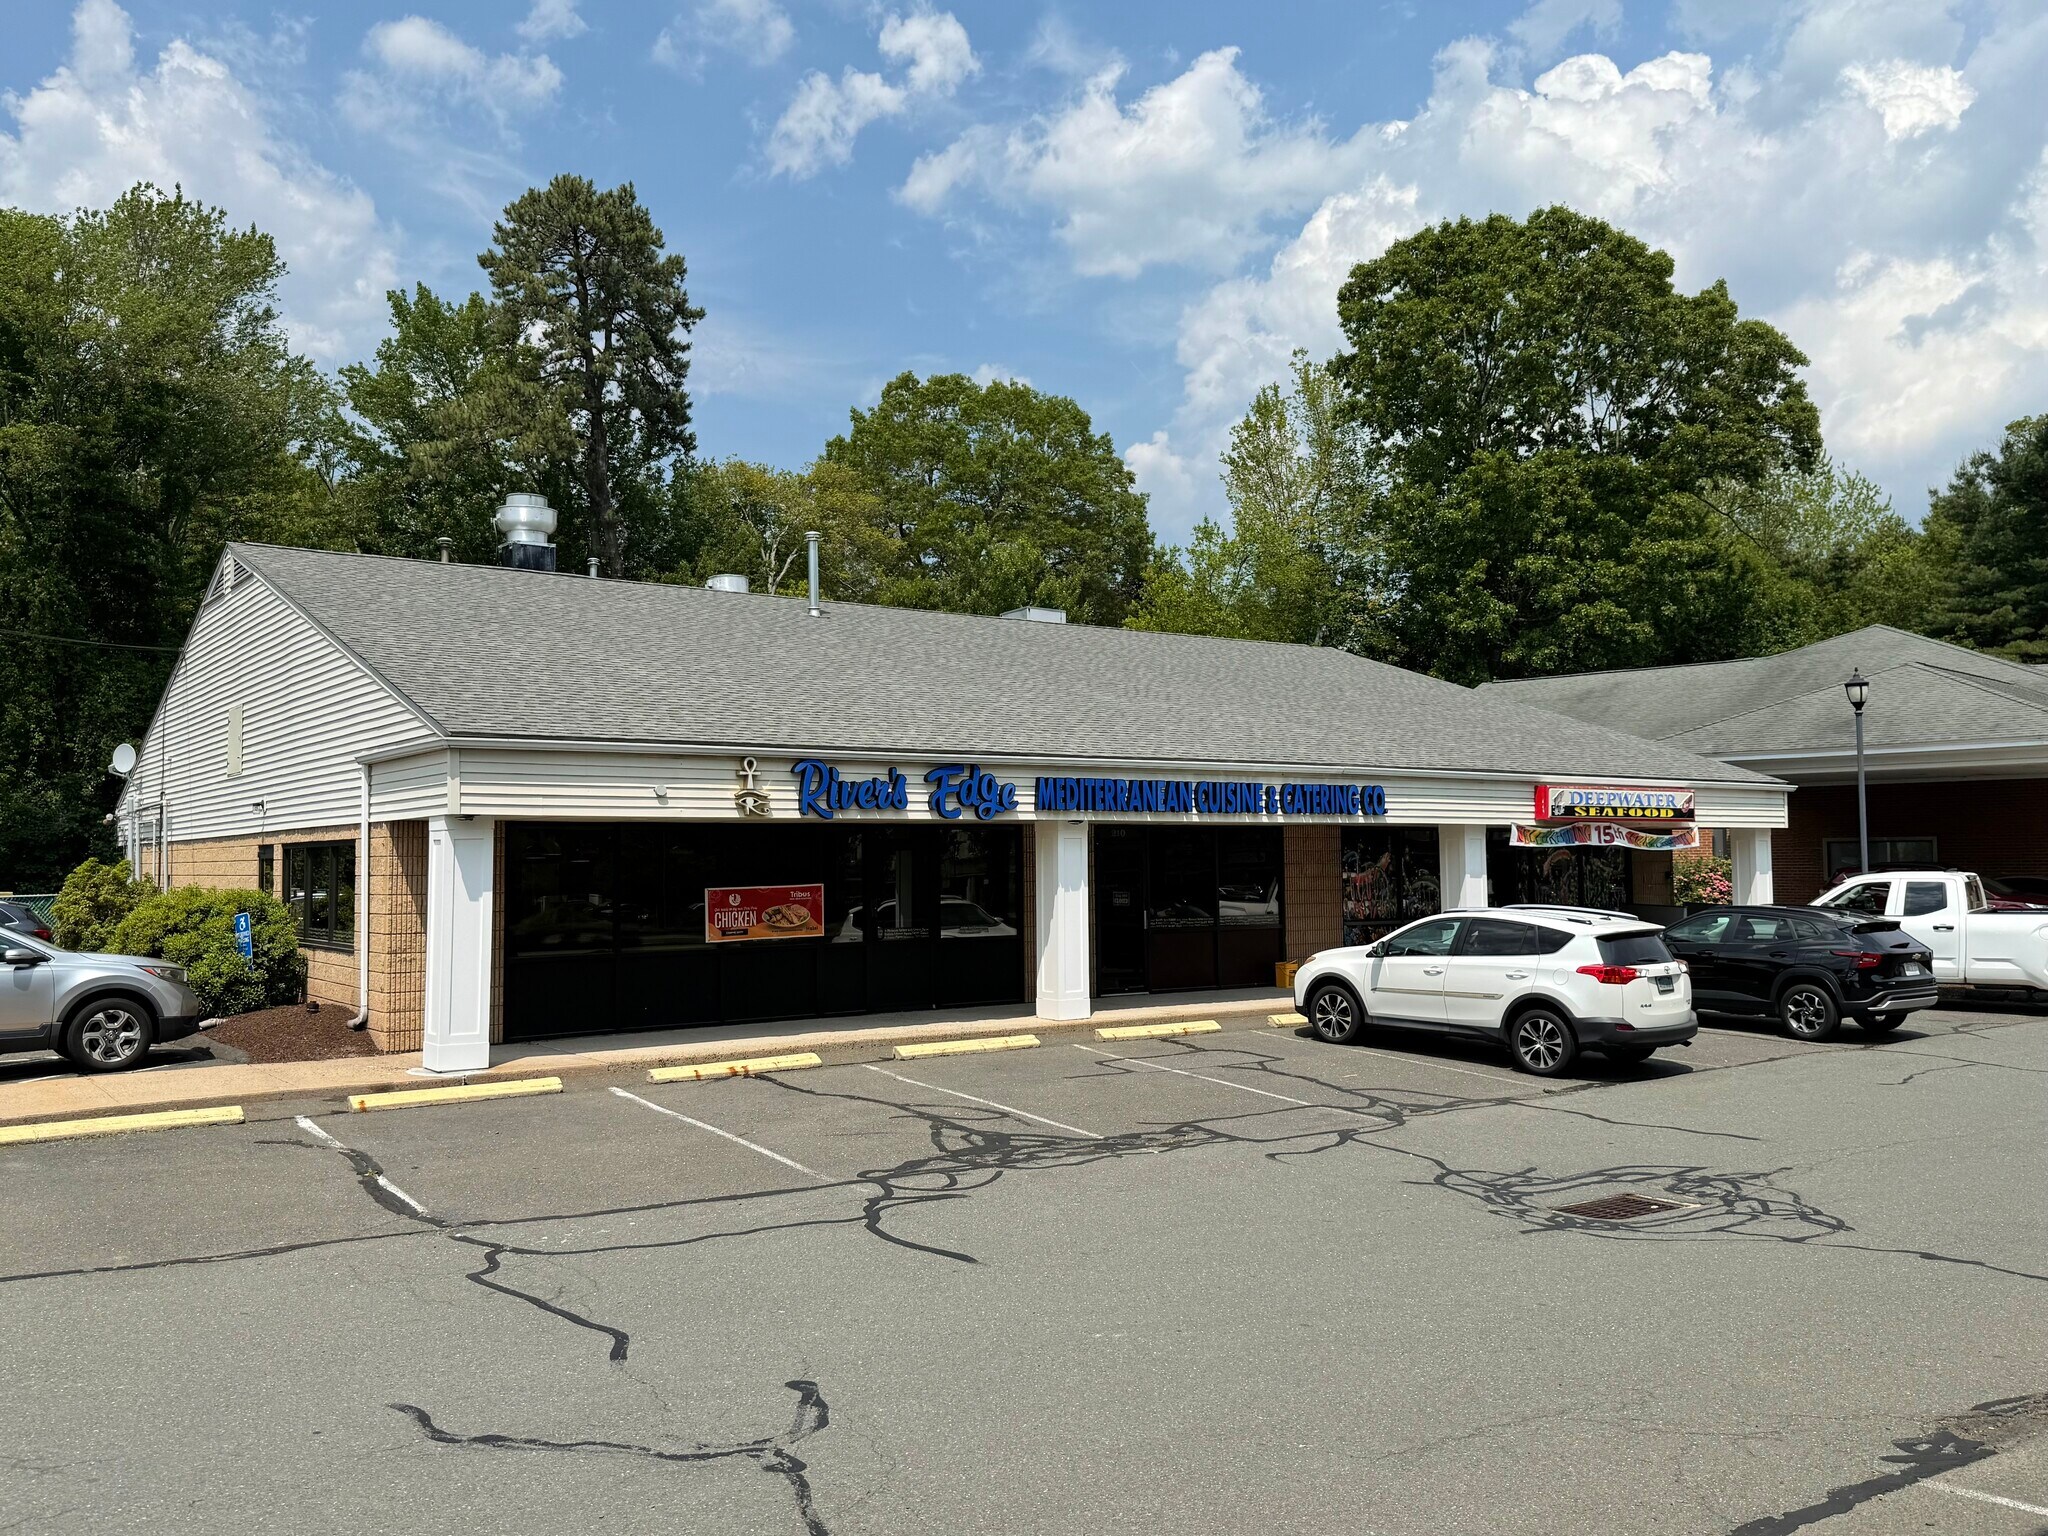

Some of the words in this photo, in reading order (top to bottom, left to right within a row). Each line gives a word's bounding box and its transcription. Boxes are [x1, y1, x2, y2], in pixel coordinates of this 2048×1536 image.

[791, 759, 908, 820] River's
[924, 764, 1019, 820] Edge
[1035, 777, 1193, 812] MEDITERRANEAN
[1194, 781, 1264, 814] CUISINE
[1265, 785, 1278, 814] &
[1280, 783, 1360, 815] CATERING
[1360, 785, 1389, 816] CO.
[1569, 791, 1678, 808] DEEPWATER
[1574, 806, 1674, 818] SEAFOOD
[1594, 825, 1625, 844] 15th
[714, 910, 757, 928] CHICKEN
